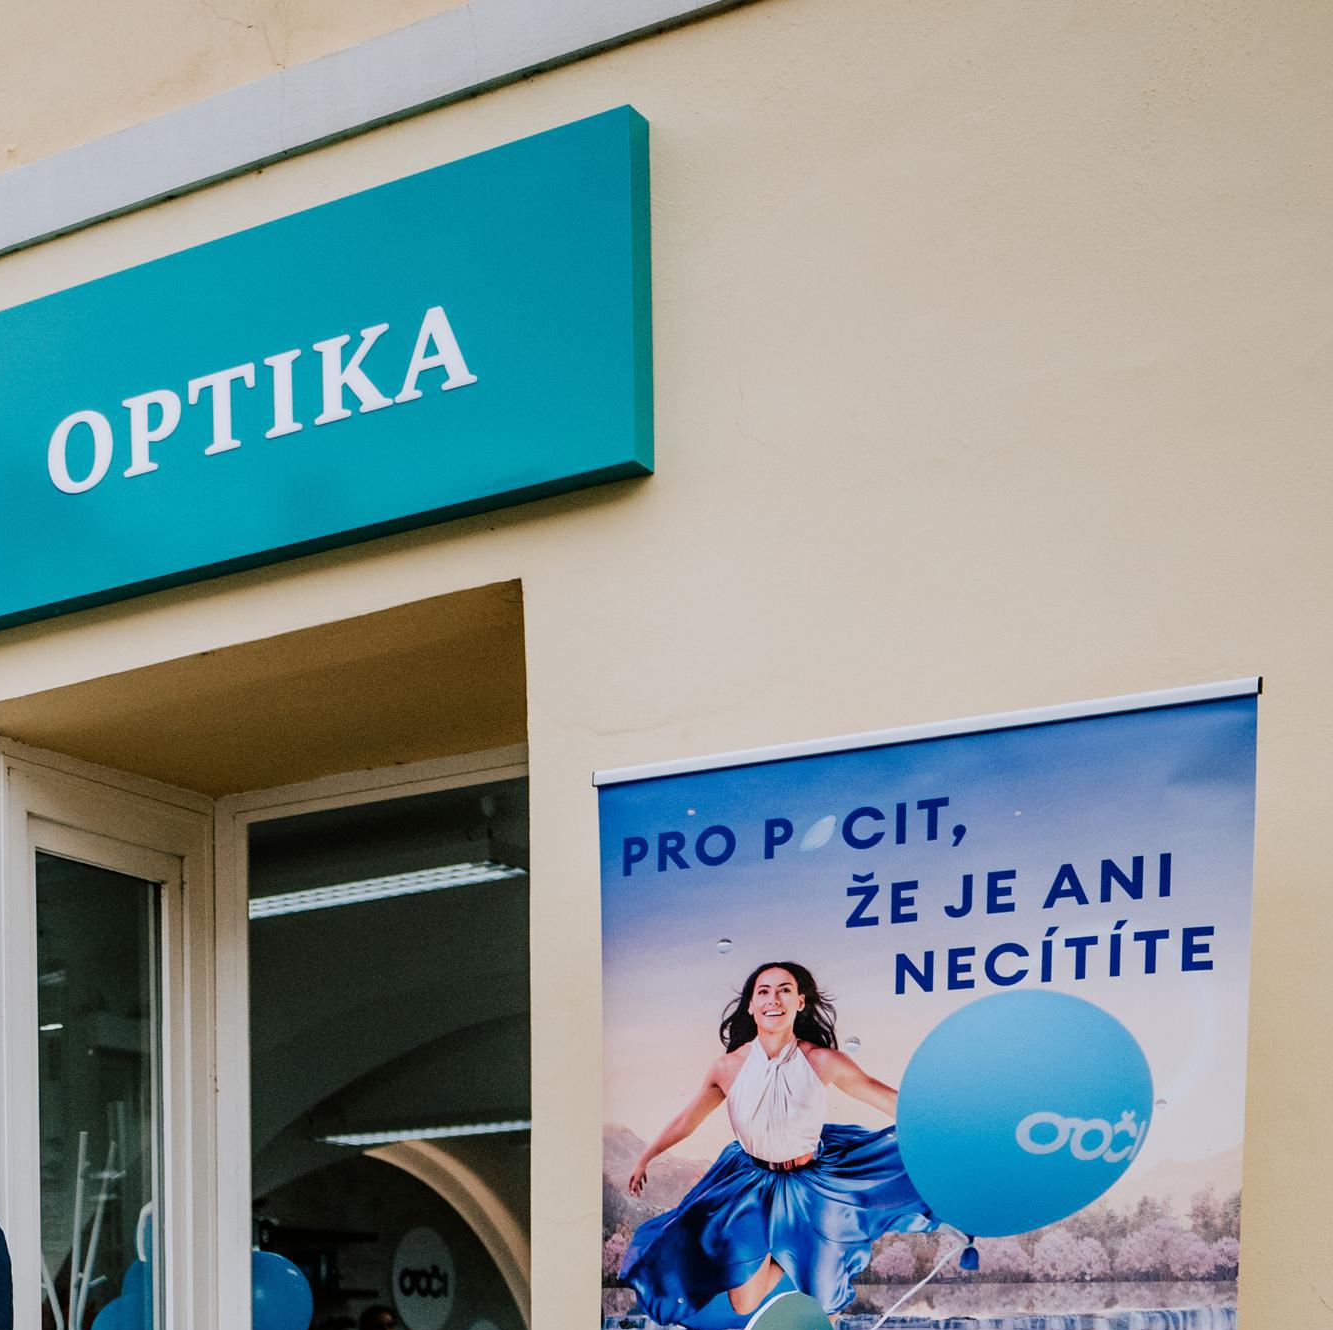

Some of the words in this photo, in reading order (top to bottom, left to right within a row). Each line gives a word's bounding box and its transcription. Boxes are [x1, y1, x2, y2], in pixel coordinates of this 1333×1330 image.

[46, 305, 478, 495] OPTIKA
[622, 824, 736, 876] PRO
[845, 873, 919, 928] ŽE
[943, 869, 1017, 918] JE
[1042, 852, 1172, 910] ANI
[894, 919, 1214, 995] NECÍTÍTE
